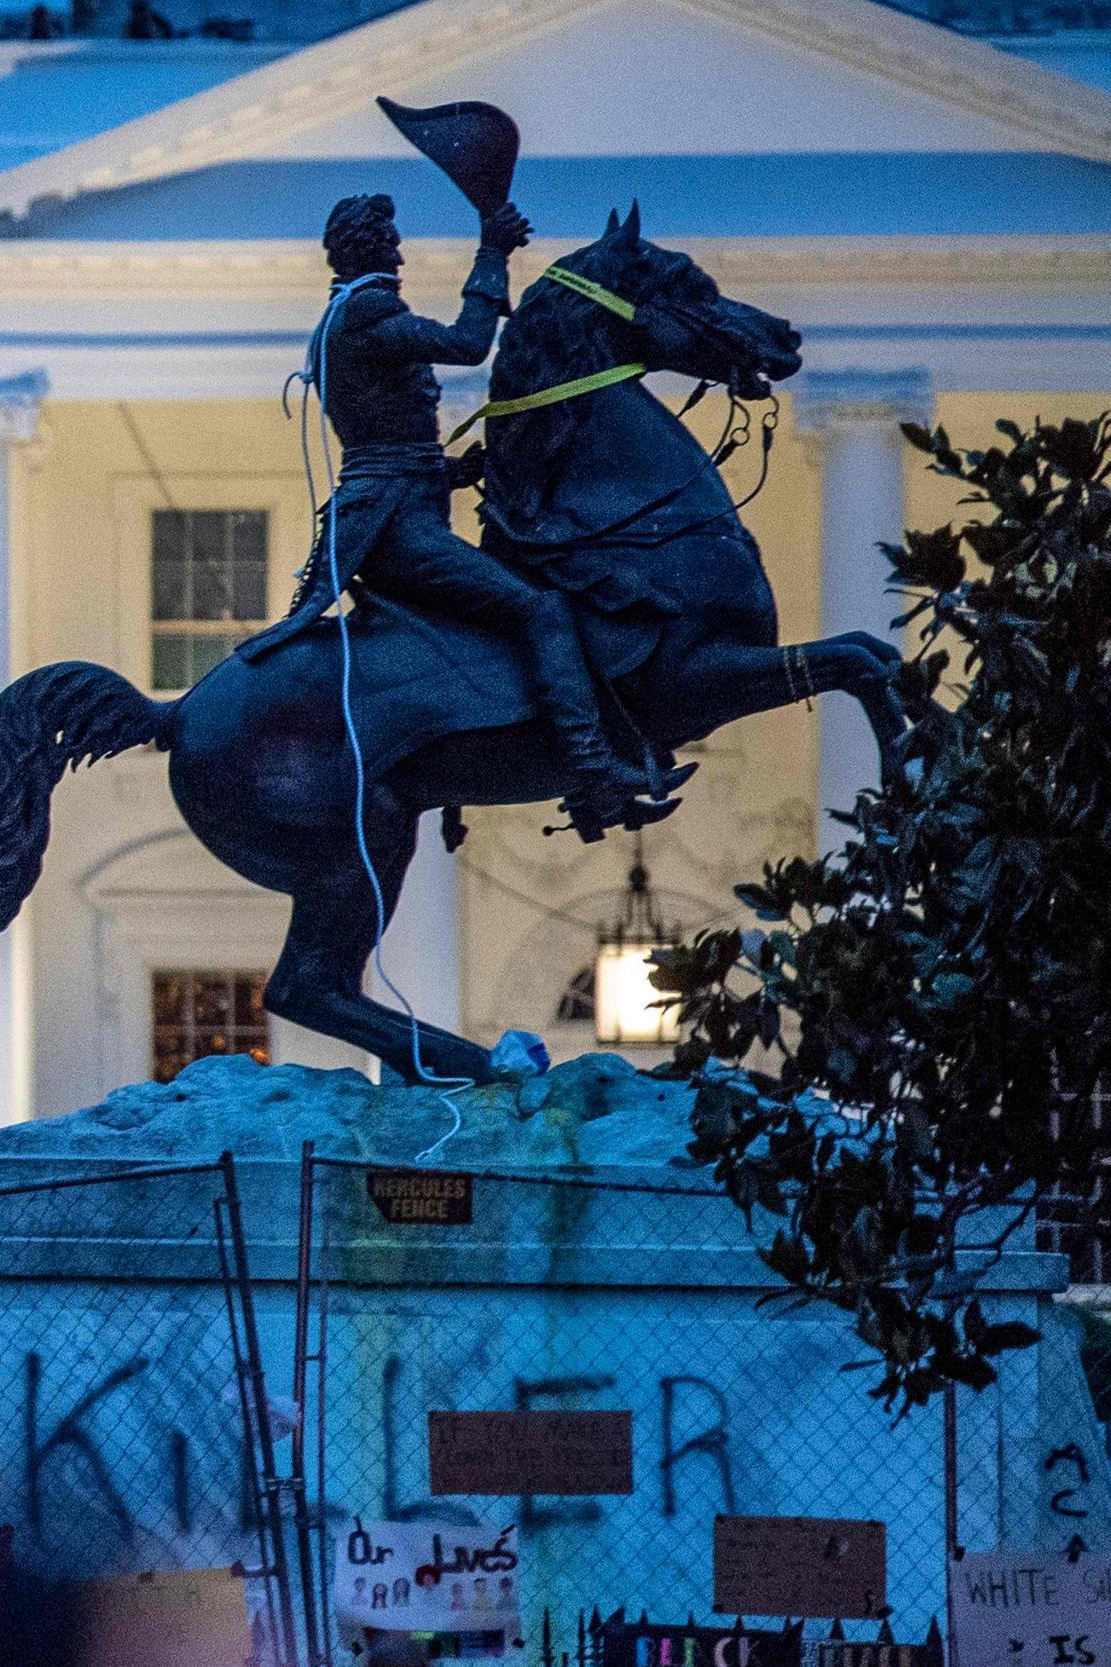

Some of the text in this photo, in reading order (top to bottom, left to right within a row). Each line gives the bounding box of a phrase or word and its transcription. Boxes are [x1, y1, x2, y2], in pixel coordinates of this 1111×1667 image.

[373, 1179, 466, 1198] HERCULES
[391, 1199, 449, 1219] FENCE
[965, 1567, 1060, 1608] WHITE
[1048, 1634, 1096, 1665] IS
